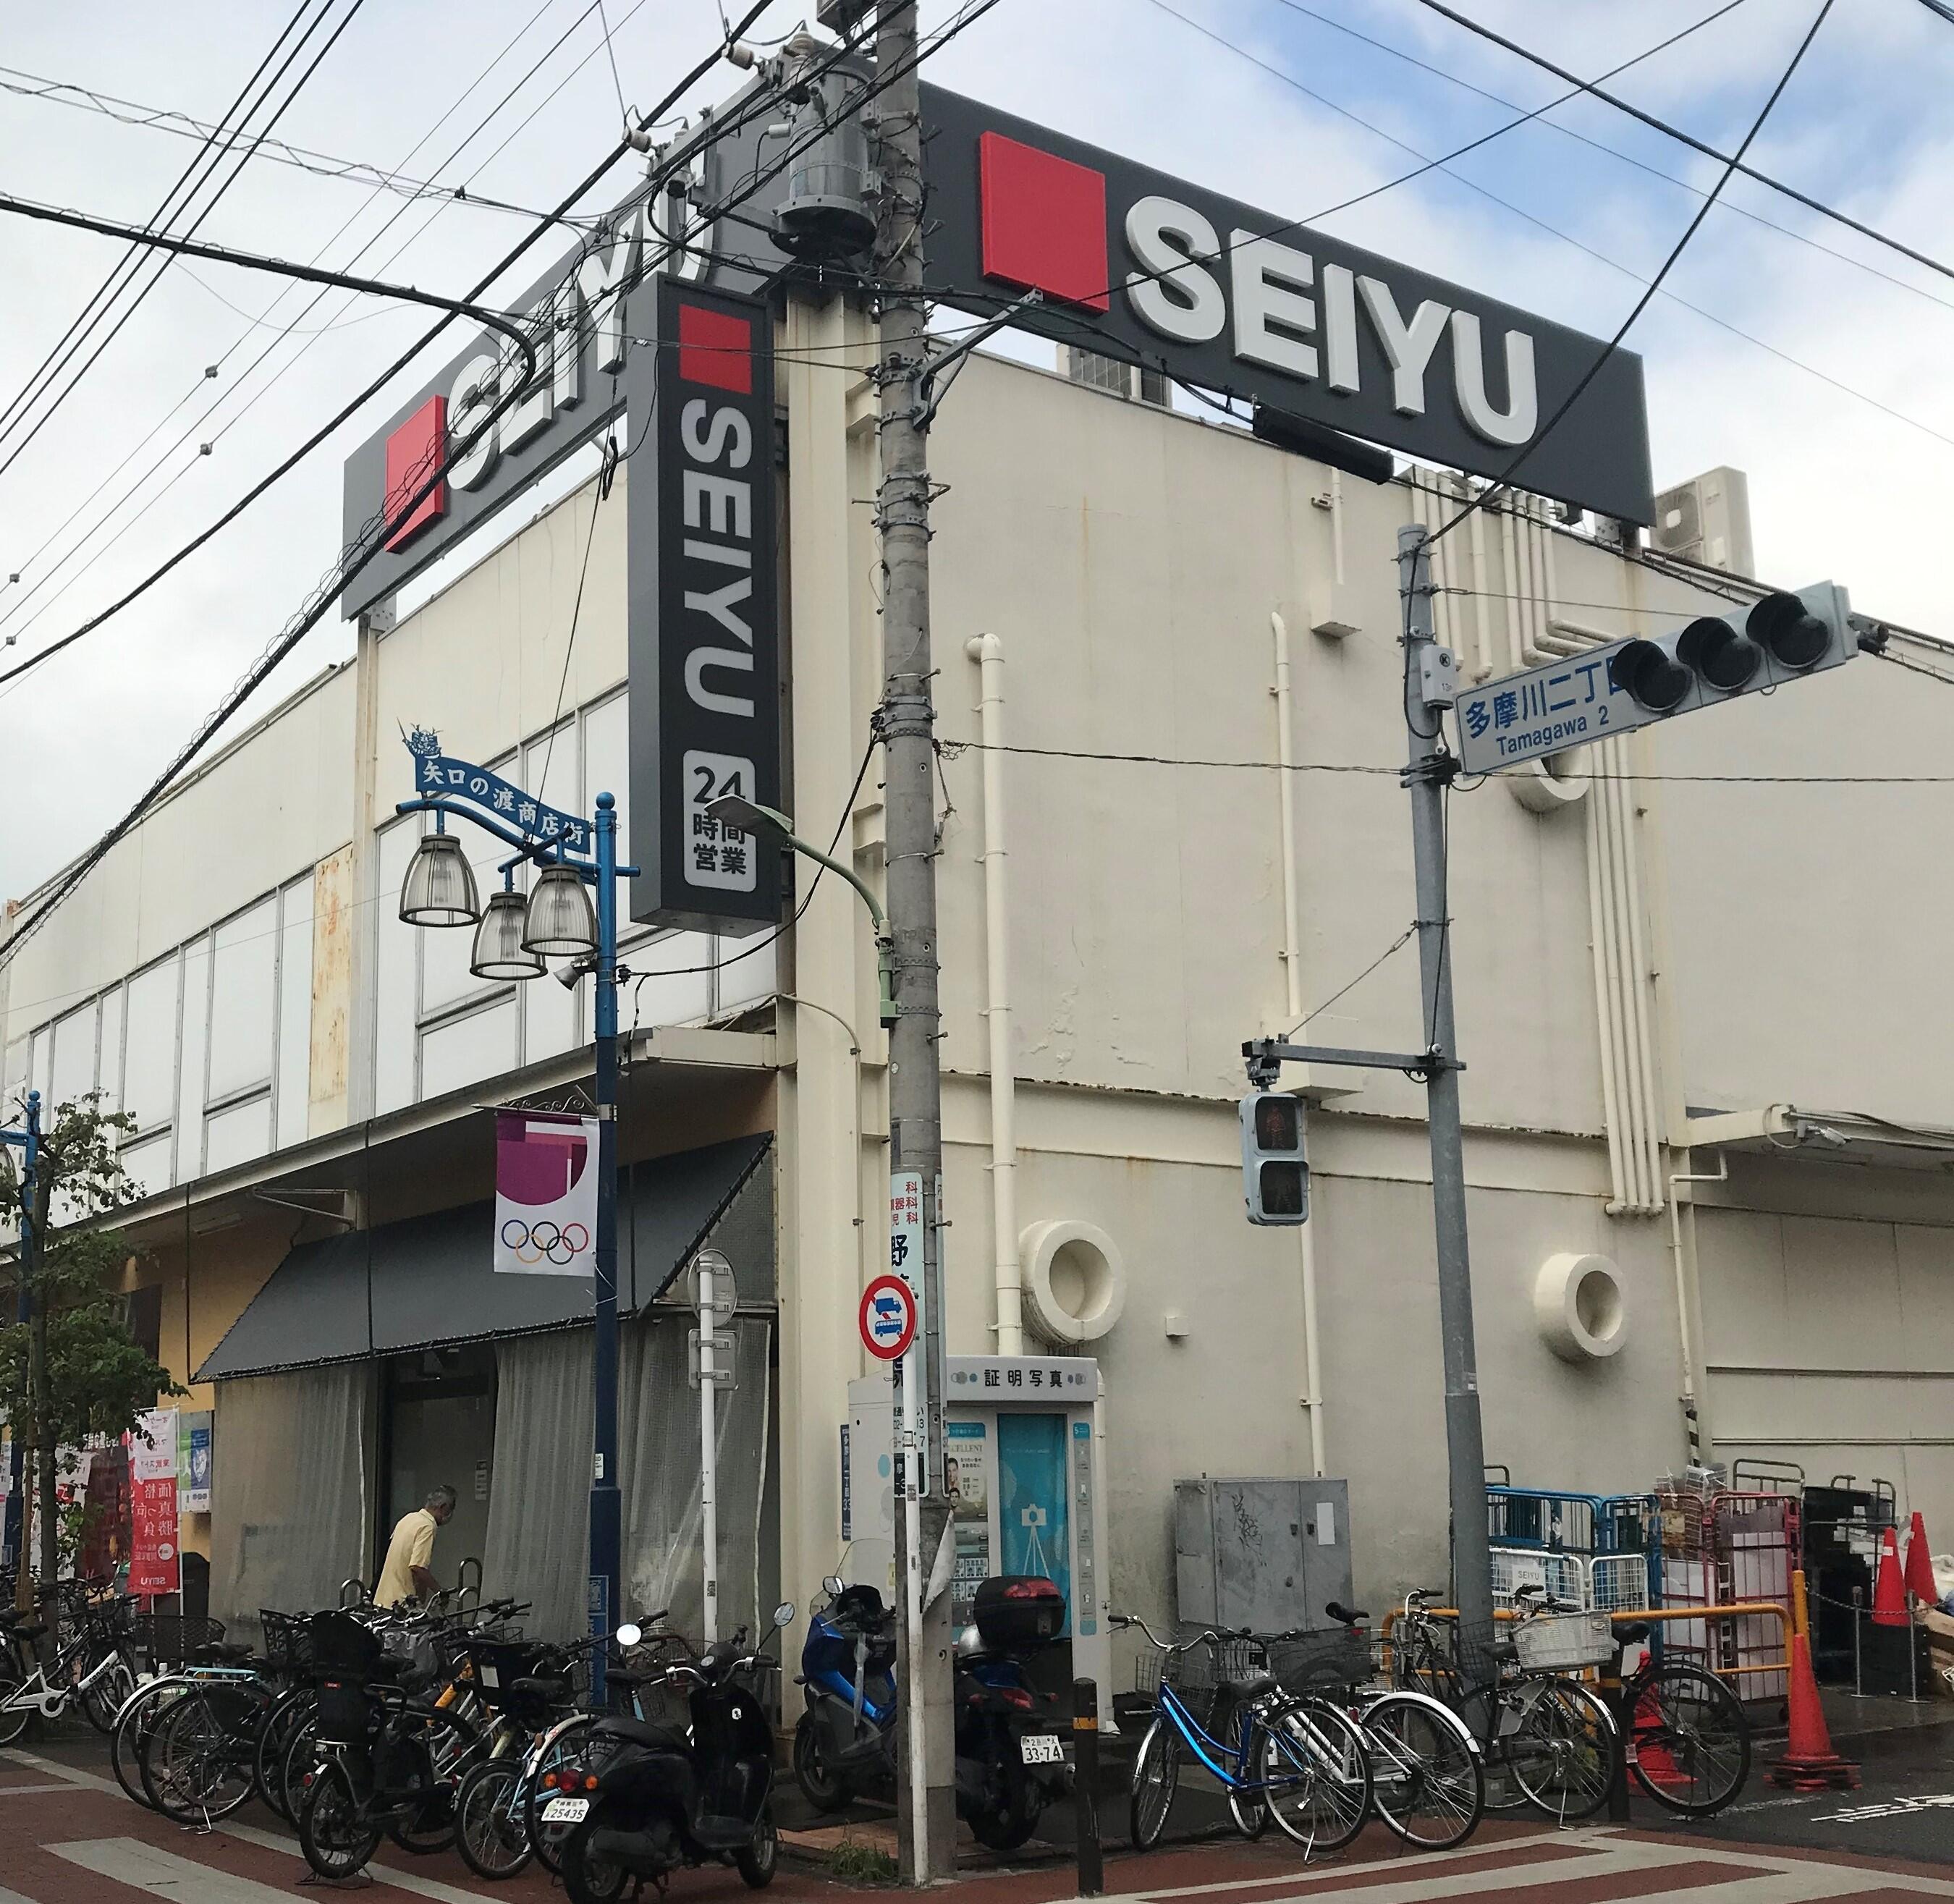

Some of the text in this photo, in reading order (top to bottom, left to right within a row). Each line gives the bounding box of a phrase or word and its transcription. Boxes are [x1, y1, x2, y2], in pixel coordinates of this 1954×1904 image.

[1125, 195, 1539, 446] SEIYU
[680, 398, 755, 718] SEIYU
[1496, 704, 1609, 756] Tamagawa 2
[693, 766, 746, 804] 24
[423, 761, 584, 845] 矢口の渡商店街
[693, 813, 745, 845] 時間
[693, 842, 747, 875] 営業
[905, 1181, 918, 1194] 科
[984, 1369, 1062, 1388] 証明写真
[1518, 1570, 1540, 1581] SEIYU
[1025, 1745, 1061, 1761] 33-74
[550, 1808, 585, 1819] 25435
